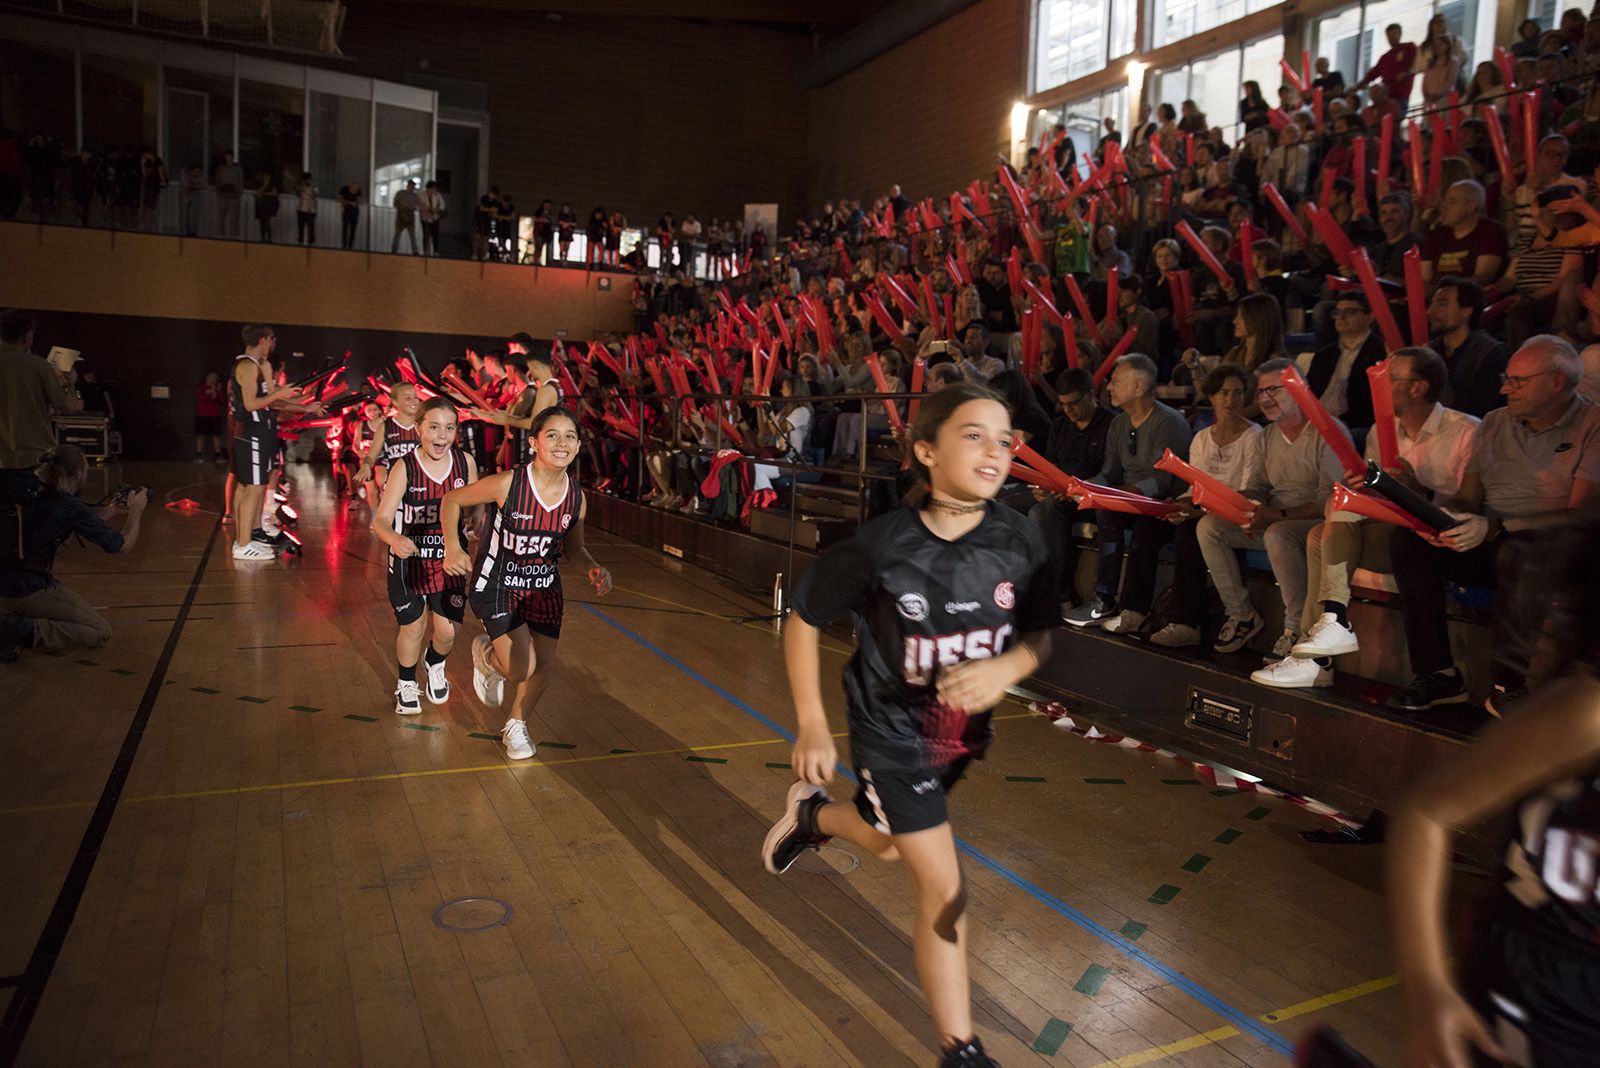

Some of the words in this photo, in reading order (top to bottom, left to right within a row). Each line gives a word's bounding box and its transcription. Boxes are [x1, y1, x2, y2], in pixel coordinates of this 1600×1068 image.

[404, 503, 438, 525] UES
[503, 528, 553, 557] UESC
[504, 575, 532, 589] SANT
